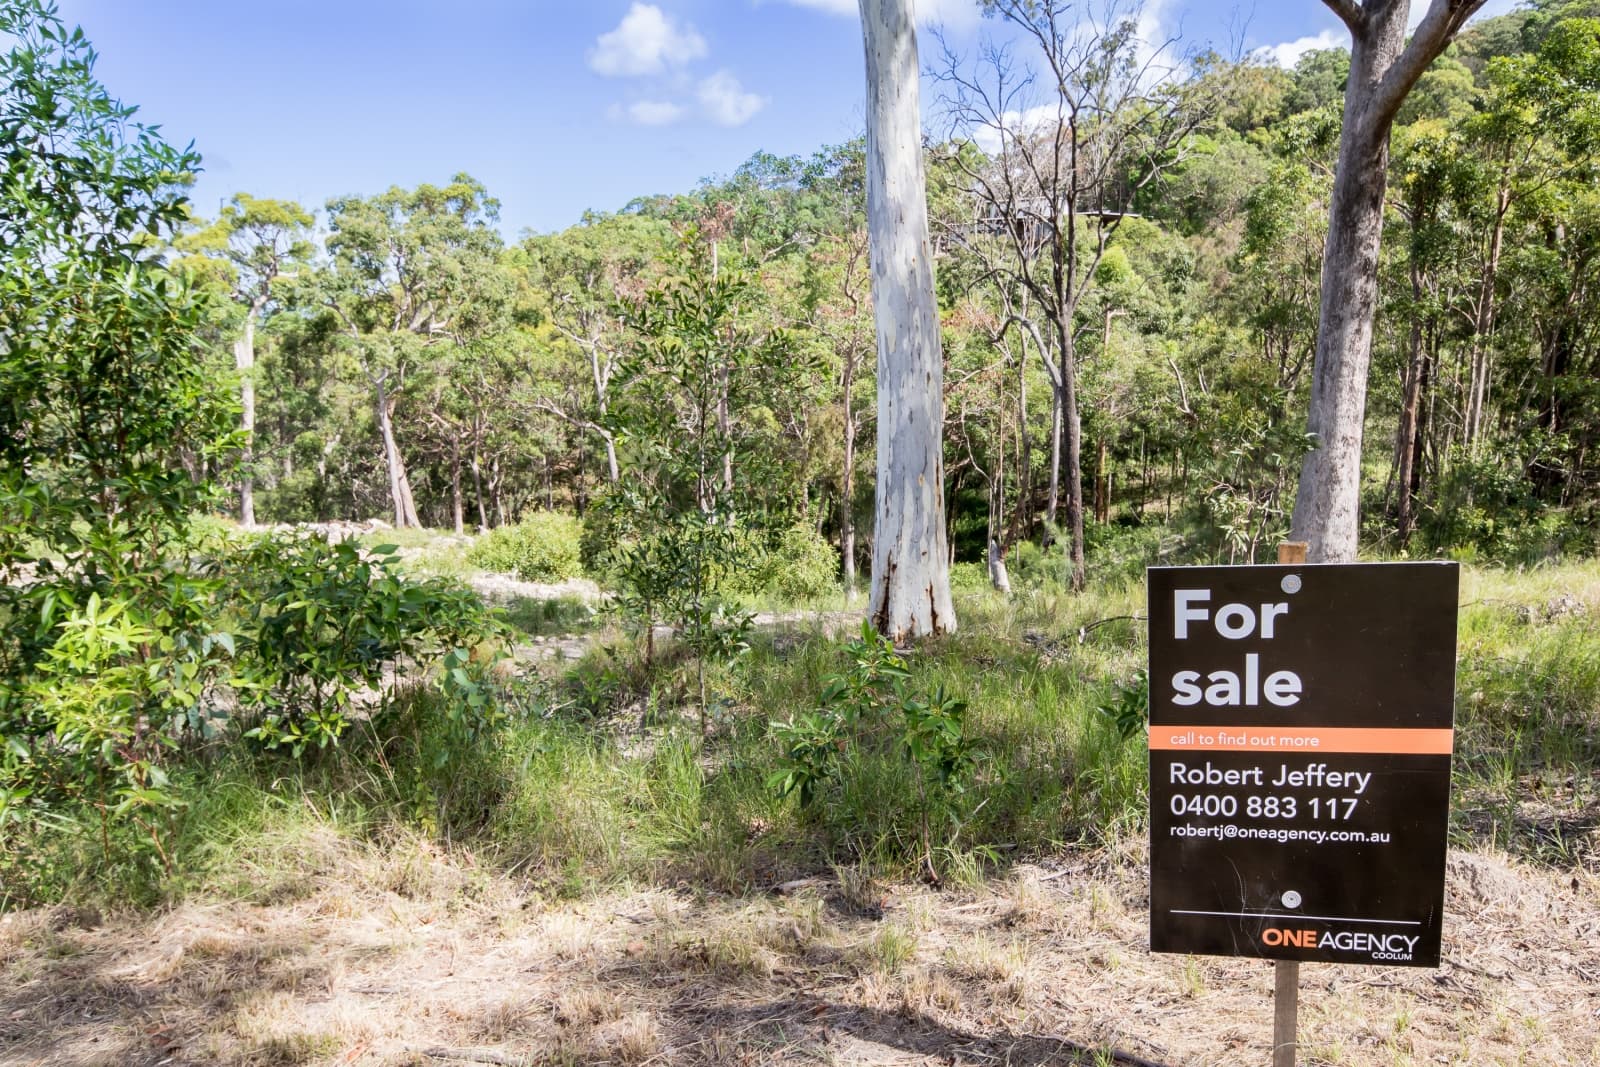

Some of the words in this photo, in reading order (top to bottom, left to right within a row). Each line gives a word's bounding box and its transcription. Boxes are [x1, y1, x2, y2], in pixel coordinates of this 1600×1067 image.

[1174, 588, 1289, 640] For
[1171, 652, 1303, 707] sale
[1170, 732, 1194, 747] call
[1198, 735, 1214, 747] to
[1218, 733, 1246, 747] find
[1250, 735, 1276, 747] out
[1280, 737, 1320, 748] more
[1170, 762, 1263, 786] Robert
[1271, 763, 1372, 794] Jeffery
[1170, 794, 1238, 817] 0400
[1246, 796, 1297, 819] 883
[1308, 797, 1359, 820] 117
[1170, 823, 1390, 844] robertj@oneagency.com.au
[1371, 951, 1413, 961] COOLUM
